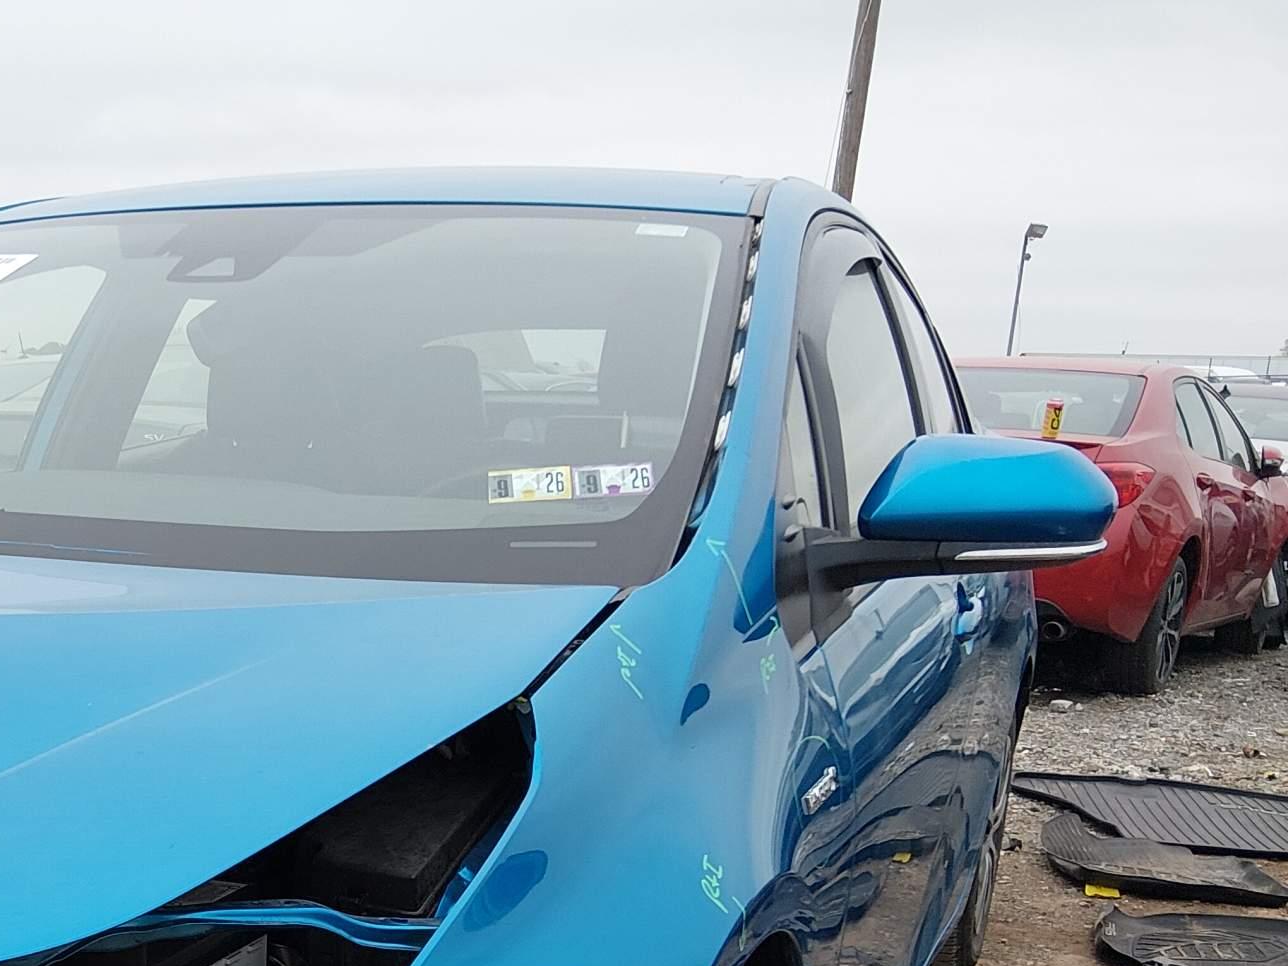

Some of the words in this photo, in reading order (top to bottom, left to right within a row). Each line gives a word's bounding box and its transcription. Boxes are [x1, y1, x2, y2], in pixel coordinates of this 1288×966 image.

[496, 479, 509, 498] 9
[545, 471, 565, 493] 26
[586, 474, 599, 494] 9
[630, 467, 650, 489] 26
